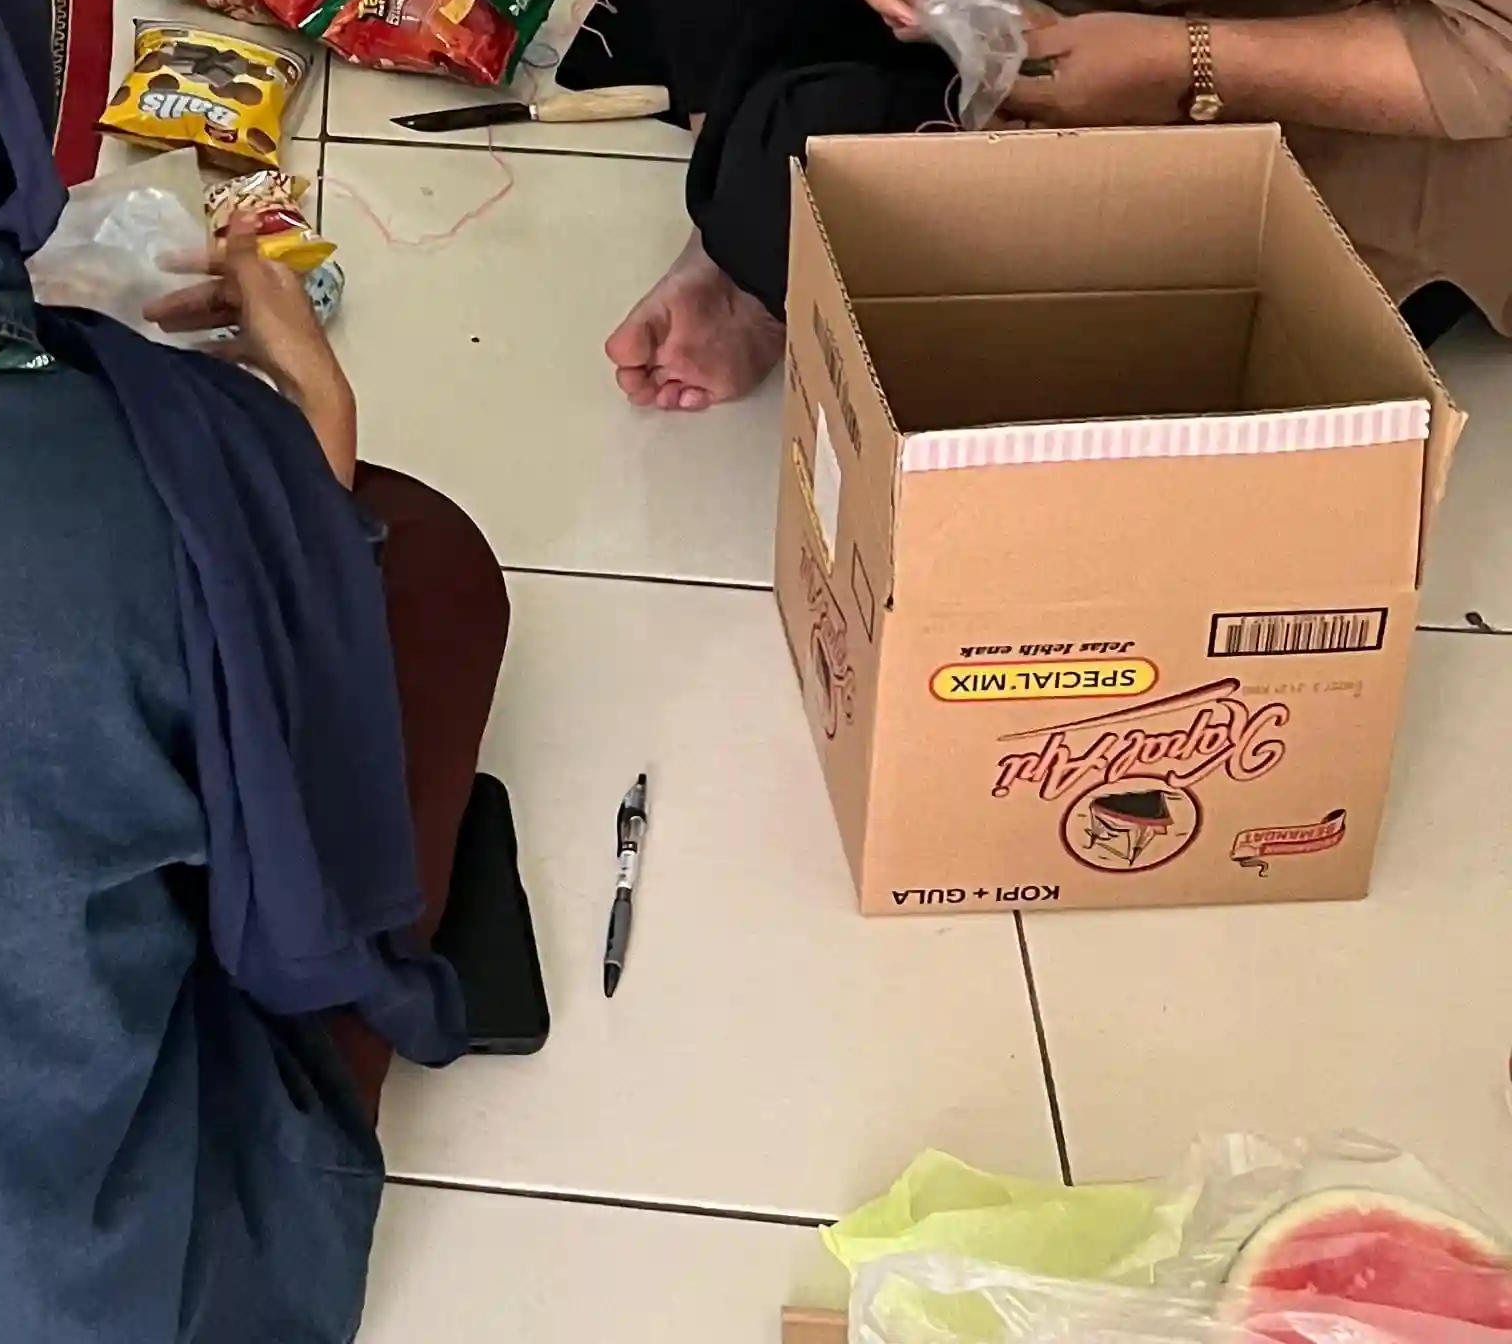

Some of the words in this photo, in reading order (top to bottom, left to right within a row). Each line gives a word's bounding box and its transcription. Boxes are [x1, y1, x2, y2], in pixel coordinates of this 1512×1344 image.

[141, 92, 239, 131] Balls
[950, 672, 1007, 693] MIX
[1016, 668, 1137, 690] SPECIAL
[1102, 696, 1291, 789] Kapal
[991, 732, 1120, 801] Api
[891, 886, 967, 906] GULA
[995, 884, 1061, 904] KOPI
